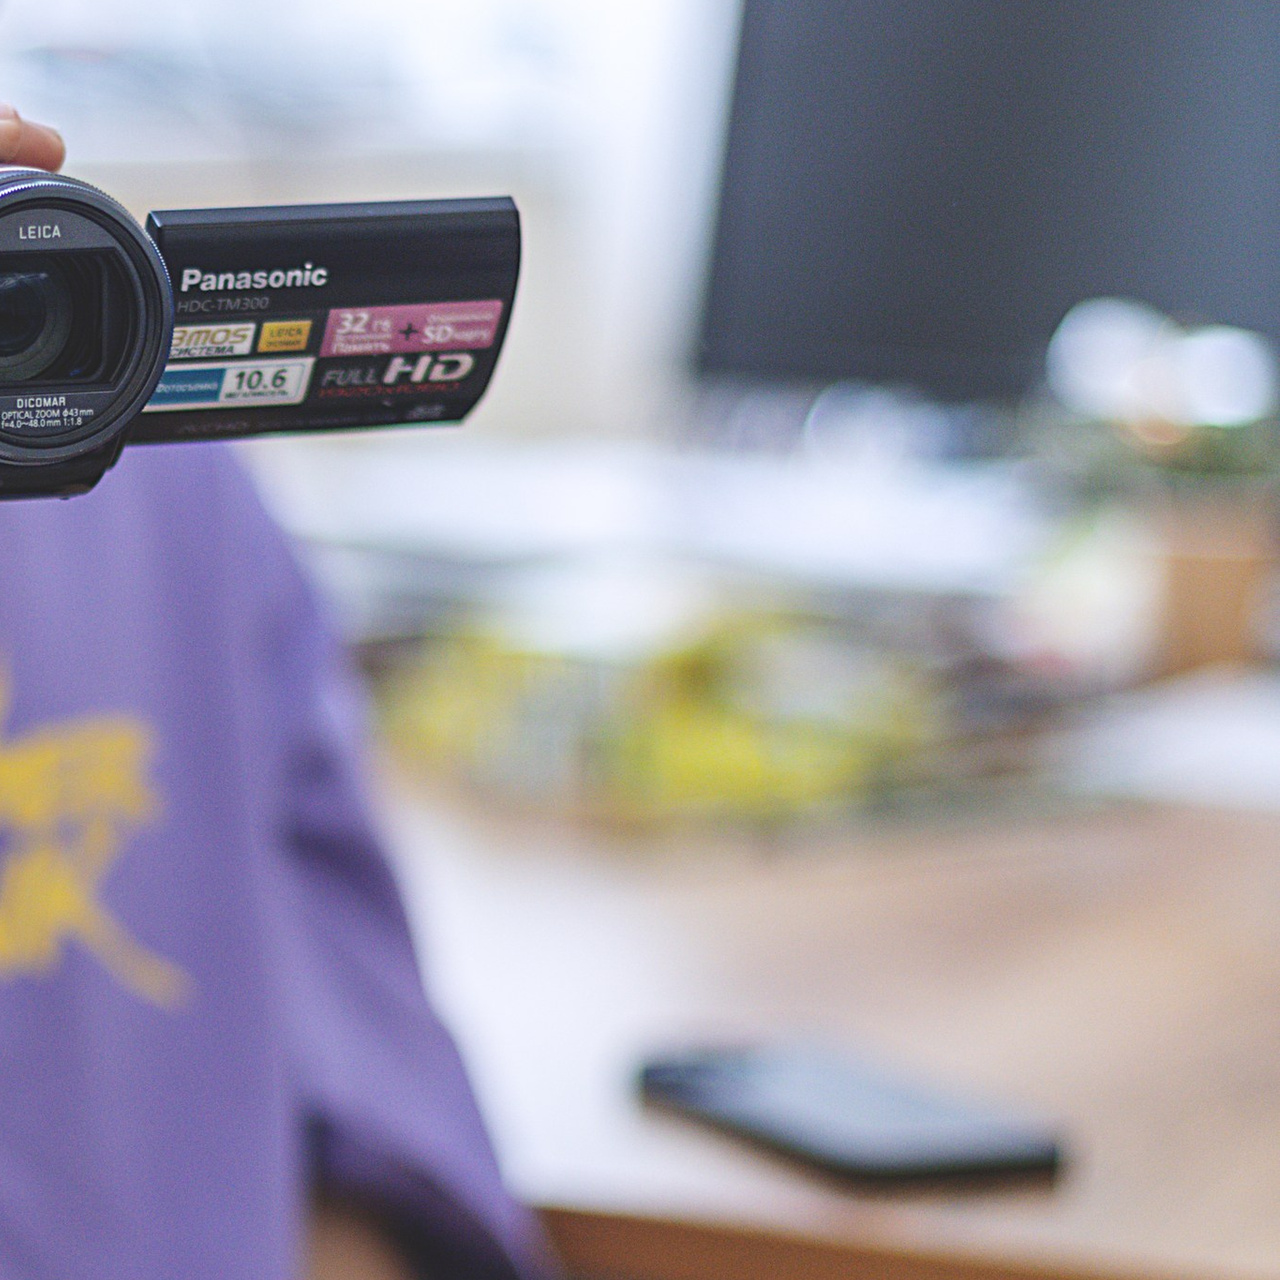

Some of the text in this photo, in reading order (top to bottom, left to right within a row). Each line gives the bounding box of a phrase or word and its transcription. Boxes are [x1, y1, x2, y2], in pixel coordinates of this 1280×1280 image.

[19, 225, 61, 239] LEICA
[181, 262, 327, 292] Panasonic
[176, 297, 269, 313] HDC-TM300
[336, 312, 369, 335] 32
[322, 353, 474, 387] FULL HD
[235, 368, 287, 391] 10.6
[16, 396, 67, 409] DICOMAR
[1, 410, 34, 421] OPTICAL
[35, 408, 60, 419] ZOOM
[63, 417, 83, 427] 1:1.8
